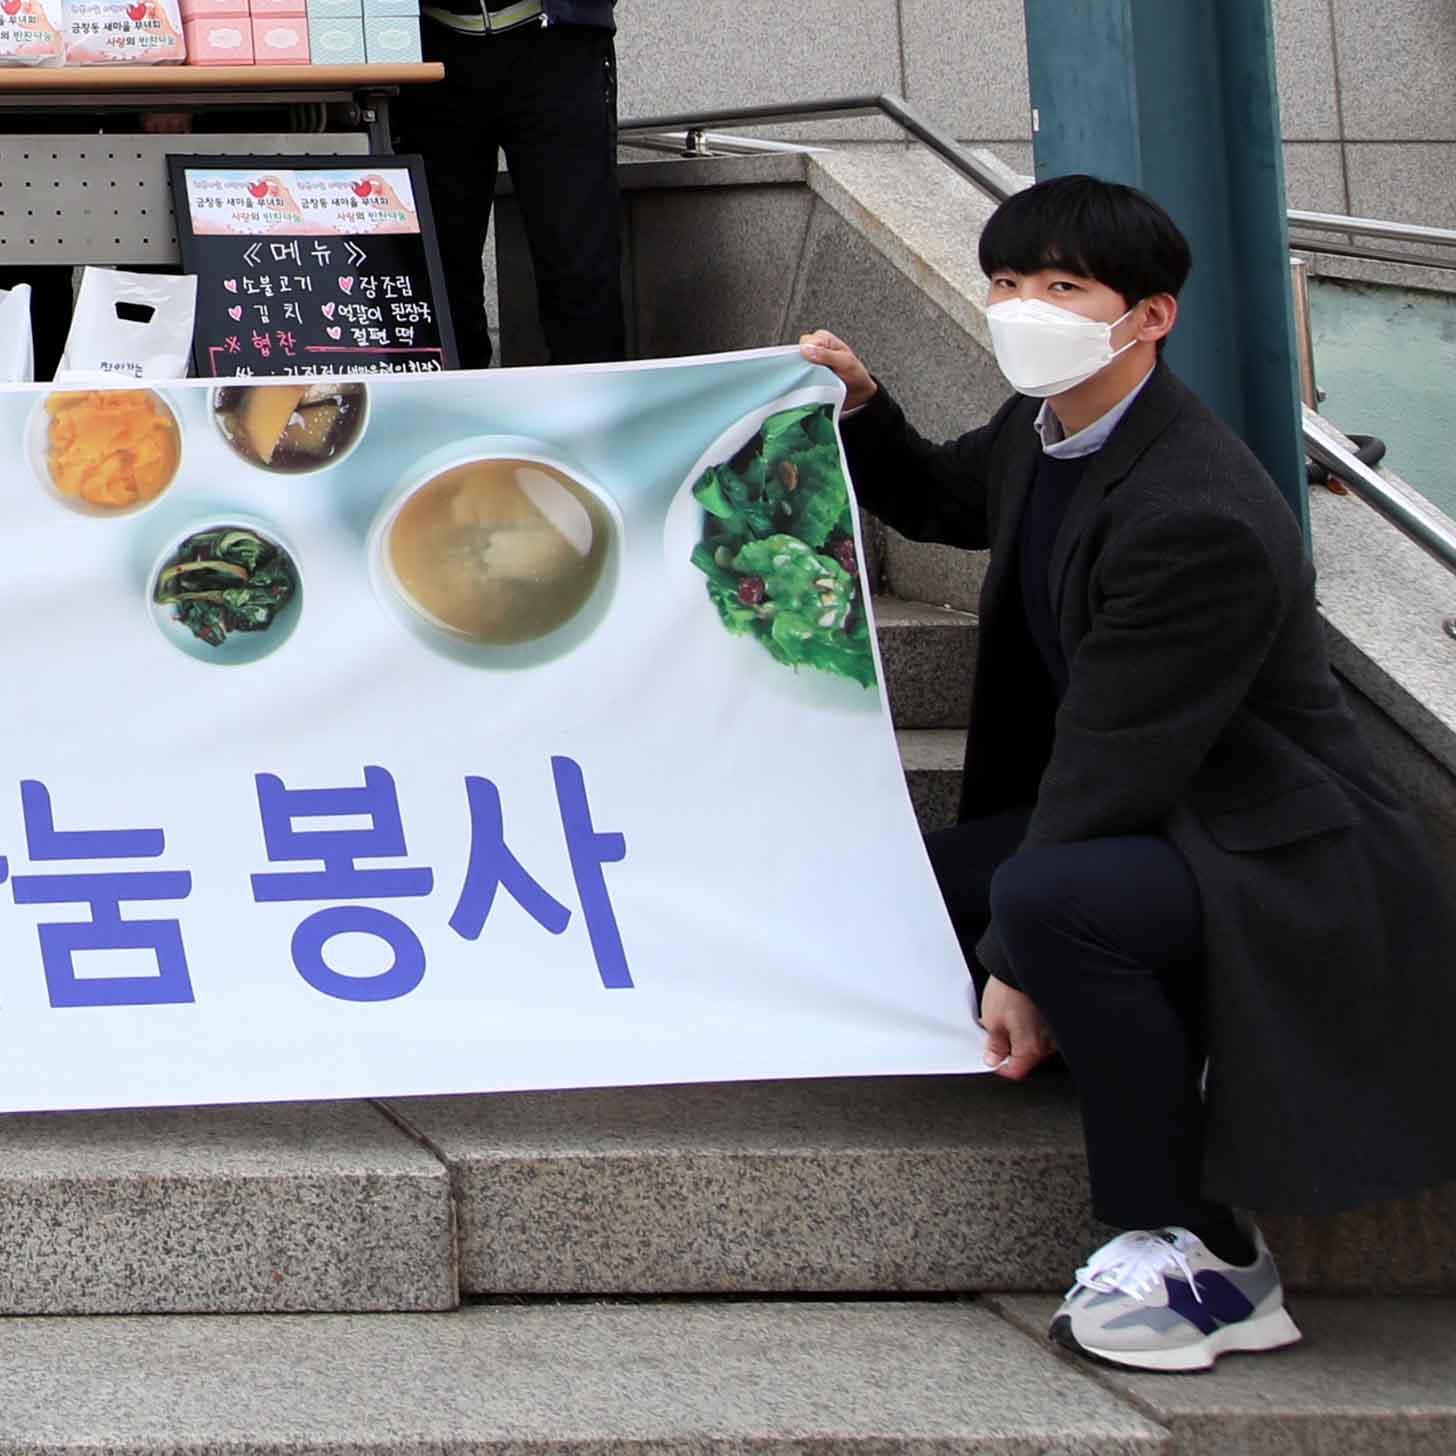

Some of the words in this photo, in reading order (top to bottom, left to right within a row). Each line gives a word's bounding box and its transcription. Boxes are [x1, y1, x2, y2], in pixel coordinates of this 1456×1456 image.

[243, 275, 313, 297] 소불고기
[359, 275, 413, 299] 장조림
[337, 303, 384, 325] 얼갈이
[390, 301, 432, 324] 된장국
[251, 329, 297, 357] 협찬
[350, 327, 391, 347] 절편
[395, 326, 416, 346] 떡
[249, 754, 636, 1003] 봉사
